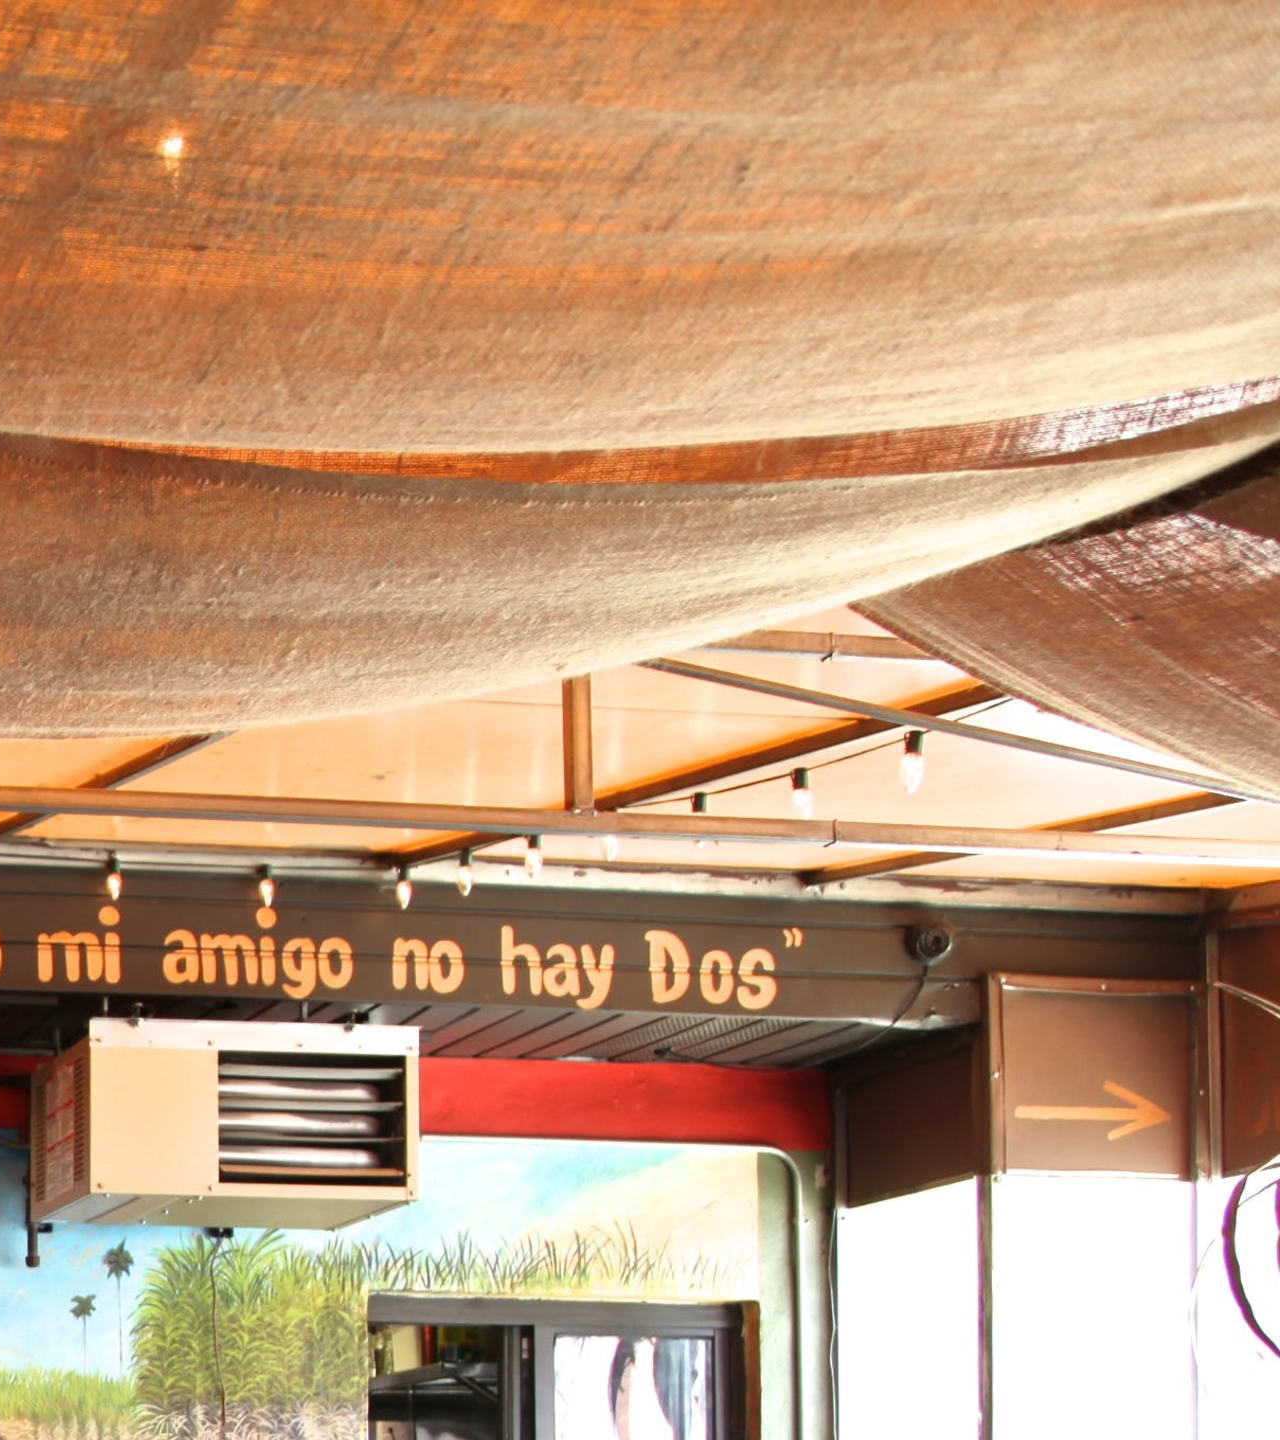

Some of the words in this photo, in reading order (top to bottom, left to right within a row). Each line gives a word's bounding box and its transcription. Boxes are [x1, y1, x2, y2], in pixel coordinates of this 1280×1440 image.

[37, 905, 121, 984] mi
[163, 905, 353, 998] amigo
[391, 935, 465, 994] no
[500, 924, 616, 1009] hay
